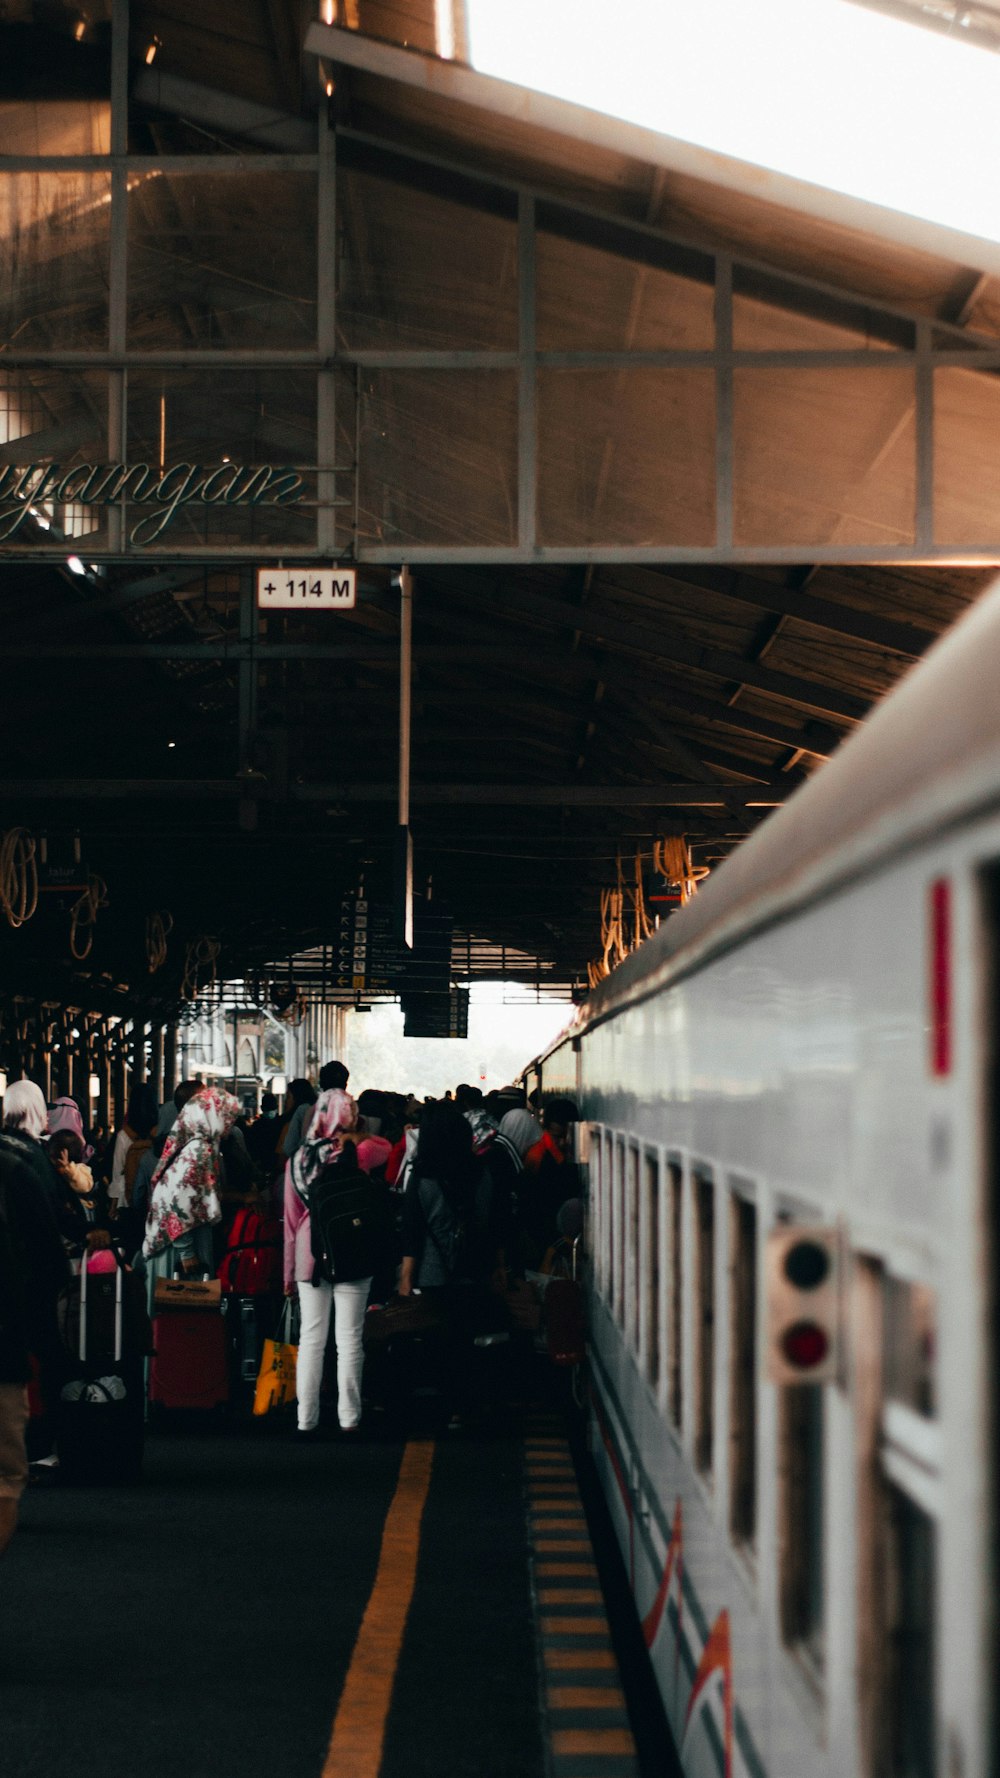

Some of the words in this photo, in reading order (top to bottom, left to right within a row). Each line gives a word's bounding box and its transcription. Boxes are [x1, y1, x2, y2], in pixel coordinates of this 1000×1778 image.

[264, 583, 276, 595] +
[285, 580, 322, 598] 114
[331, 580, 350, 598] M
